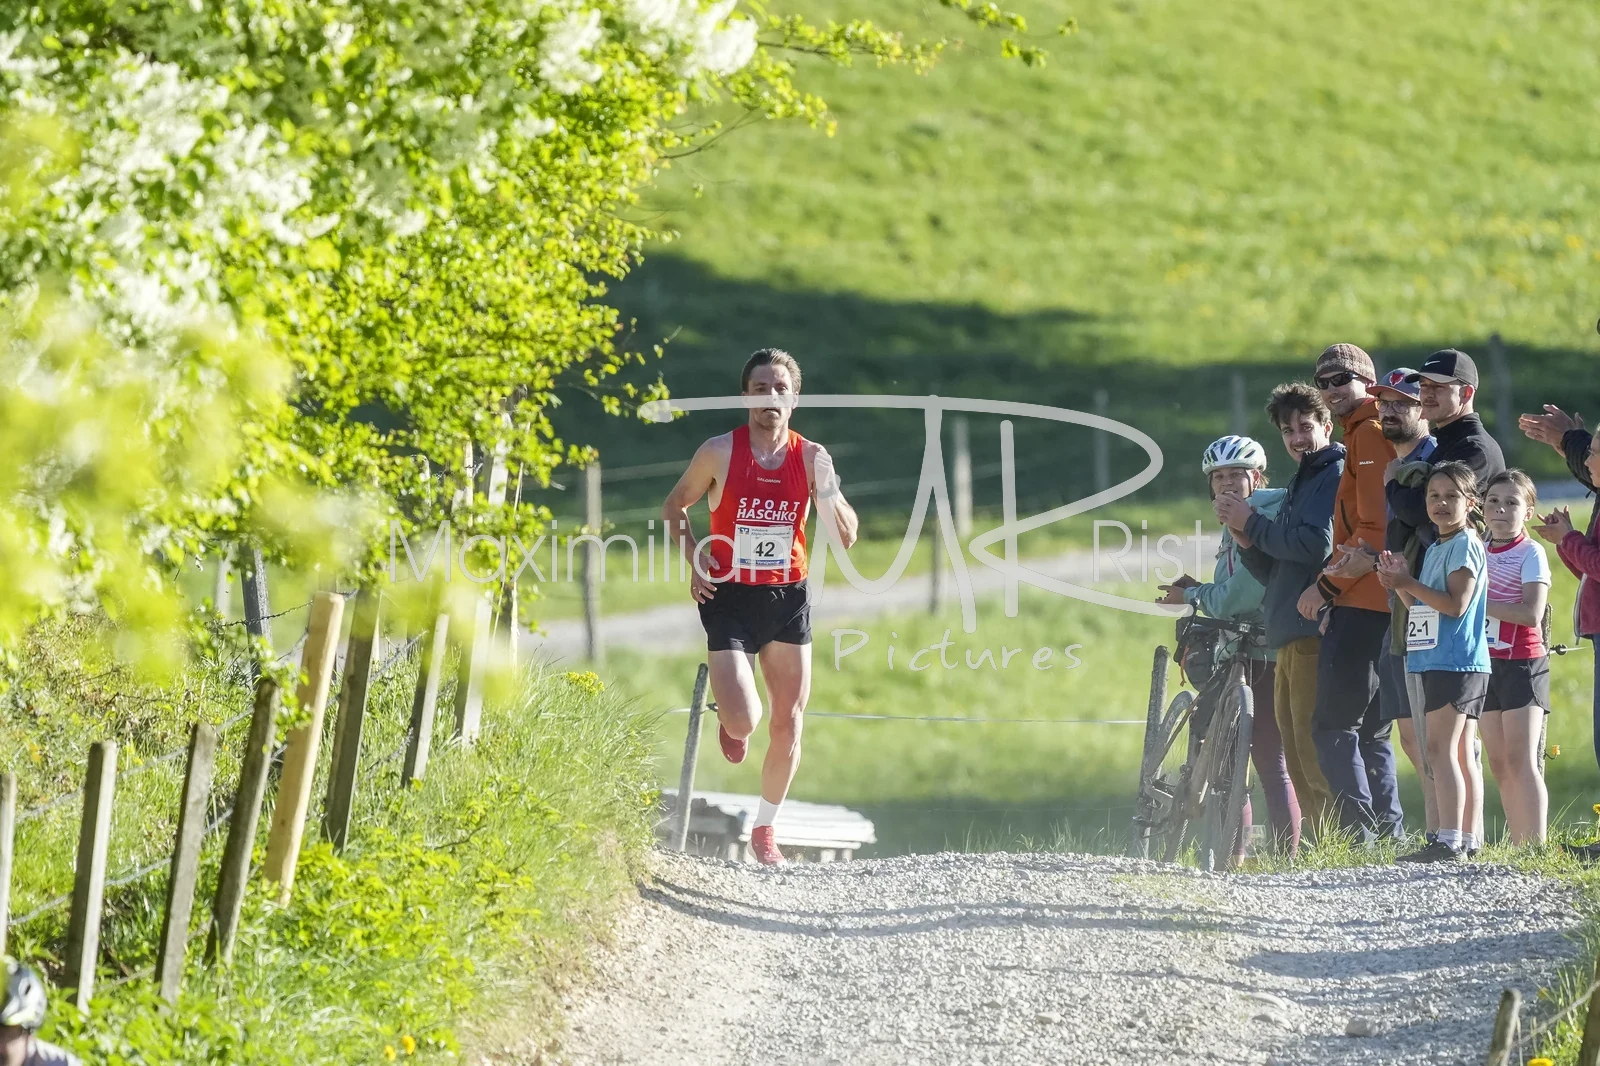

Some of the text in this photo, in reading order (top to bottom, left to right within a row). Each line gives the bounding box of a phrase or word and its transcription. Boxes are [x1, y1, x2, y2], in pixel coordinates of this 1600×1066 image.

[739, 498, 800, 511] SPORT
[737, 509, 797, 521] HASCHKO
[754, 541, 775, 557] 42
